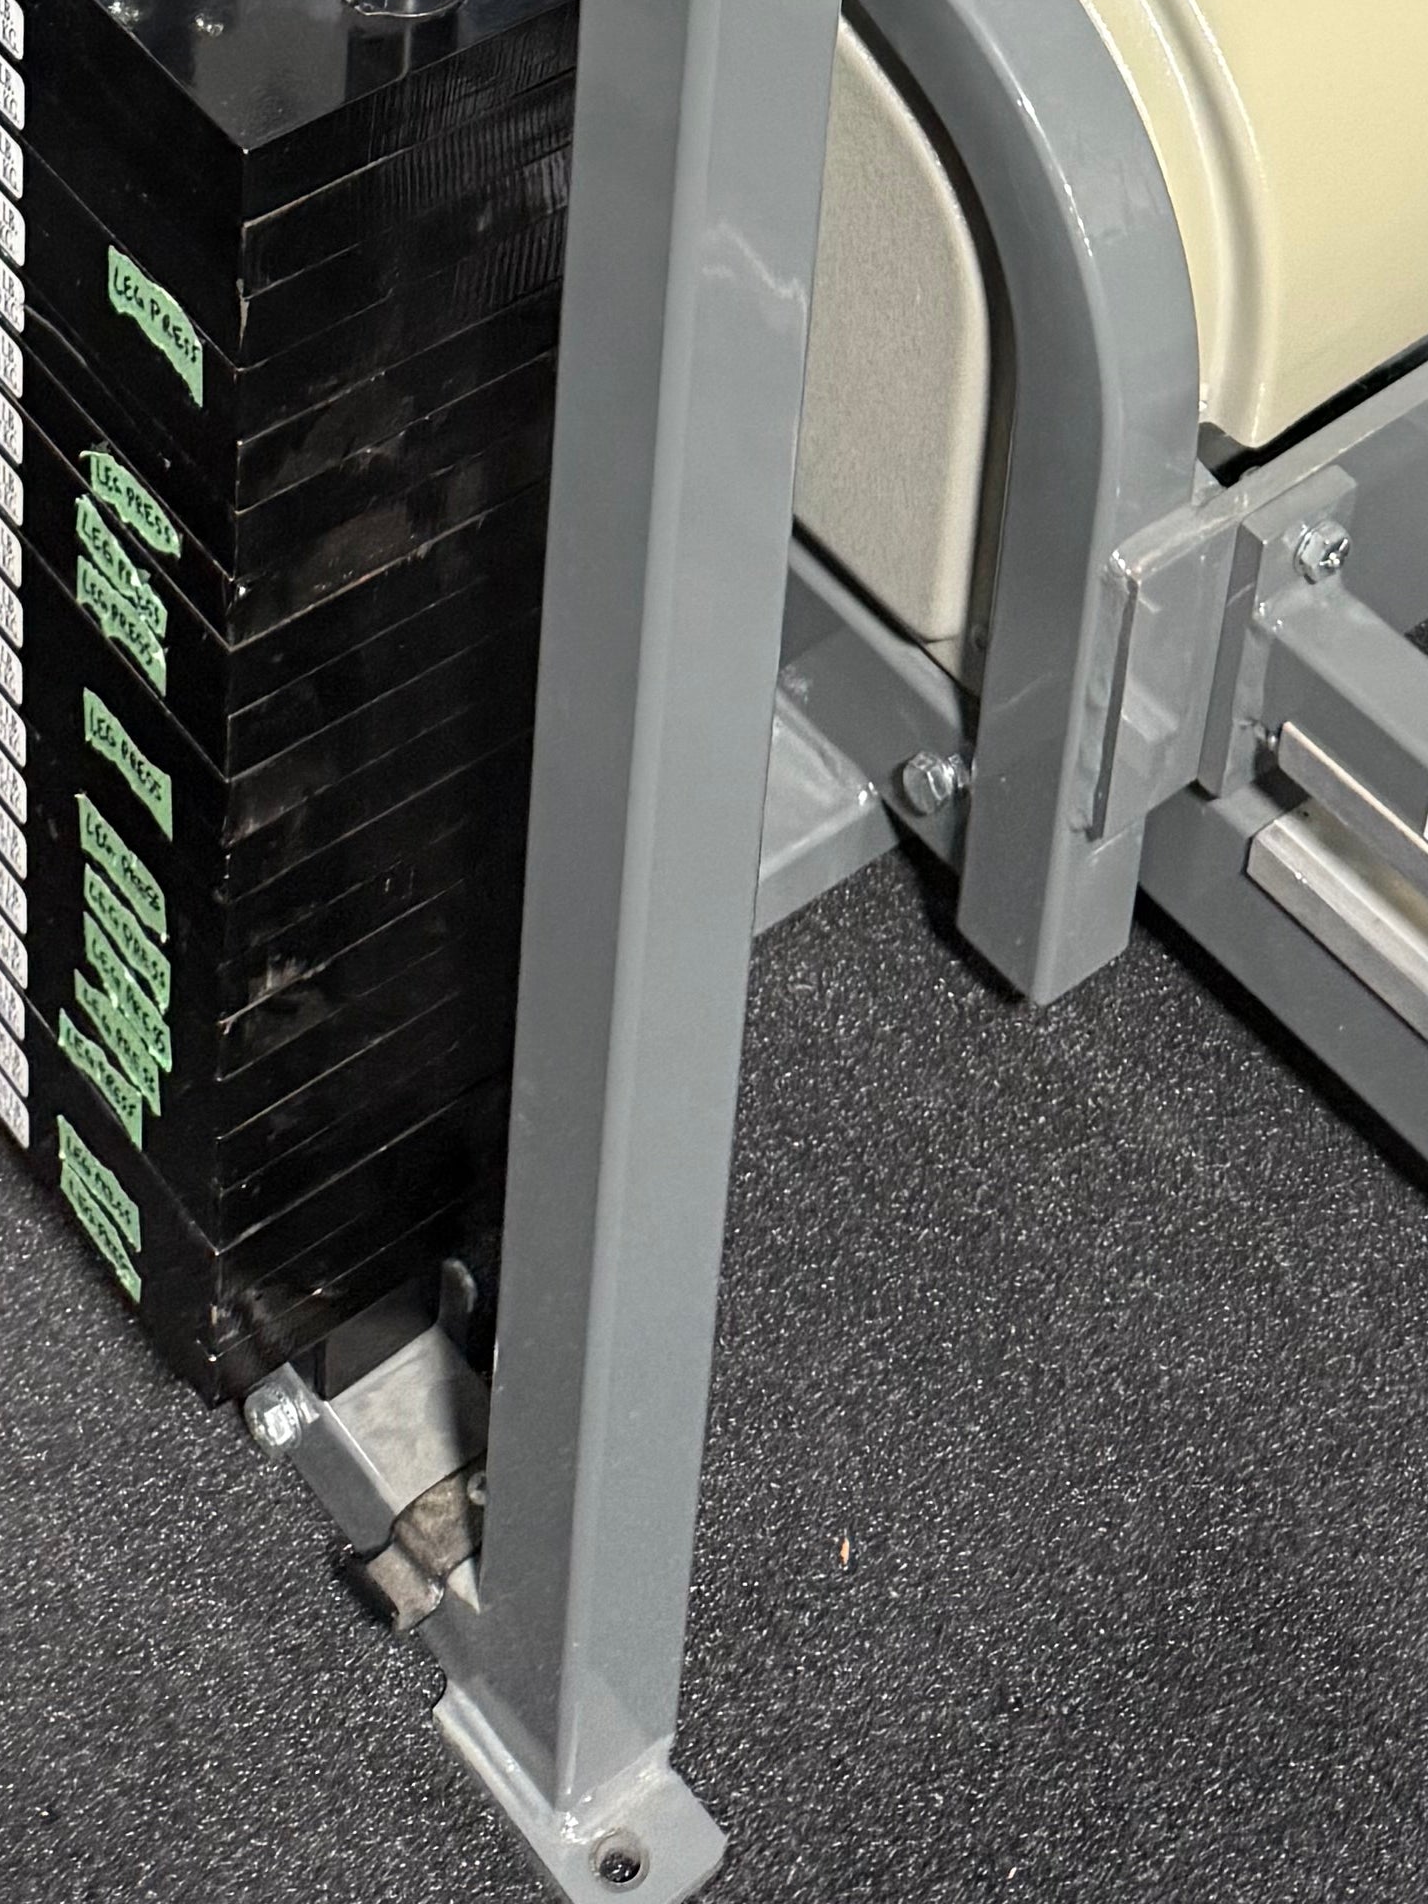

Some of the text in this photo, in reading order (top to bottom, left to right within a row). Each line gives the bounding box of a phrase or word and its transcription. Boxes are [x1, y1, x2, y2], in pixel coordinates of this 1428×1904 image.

[113, 266, 201, 364] LEG PRESS
[82, 511, 113, 567] LEG
[126, 487, 172, 544] PRESS
[90, 706, 117, 748] LEG
